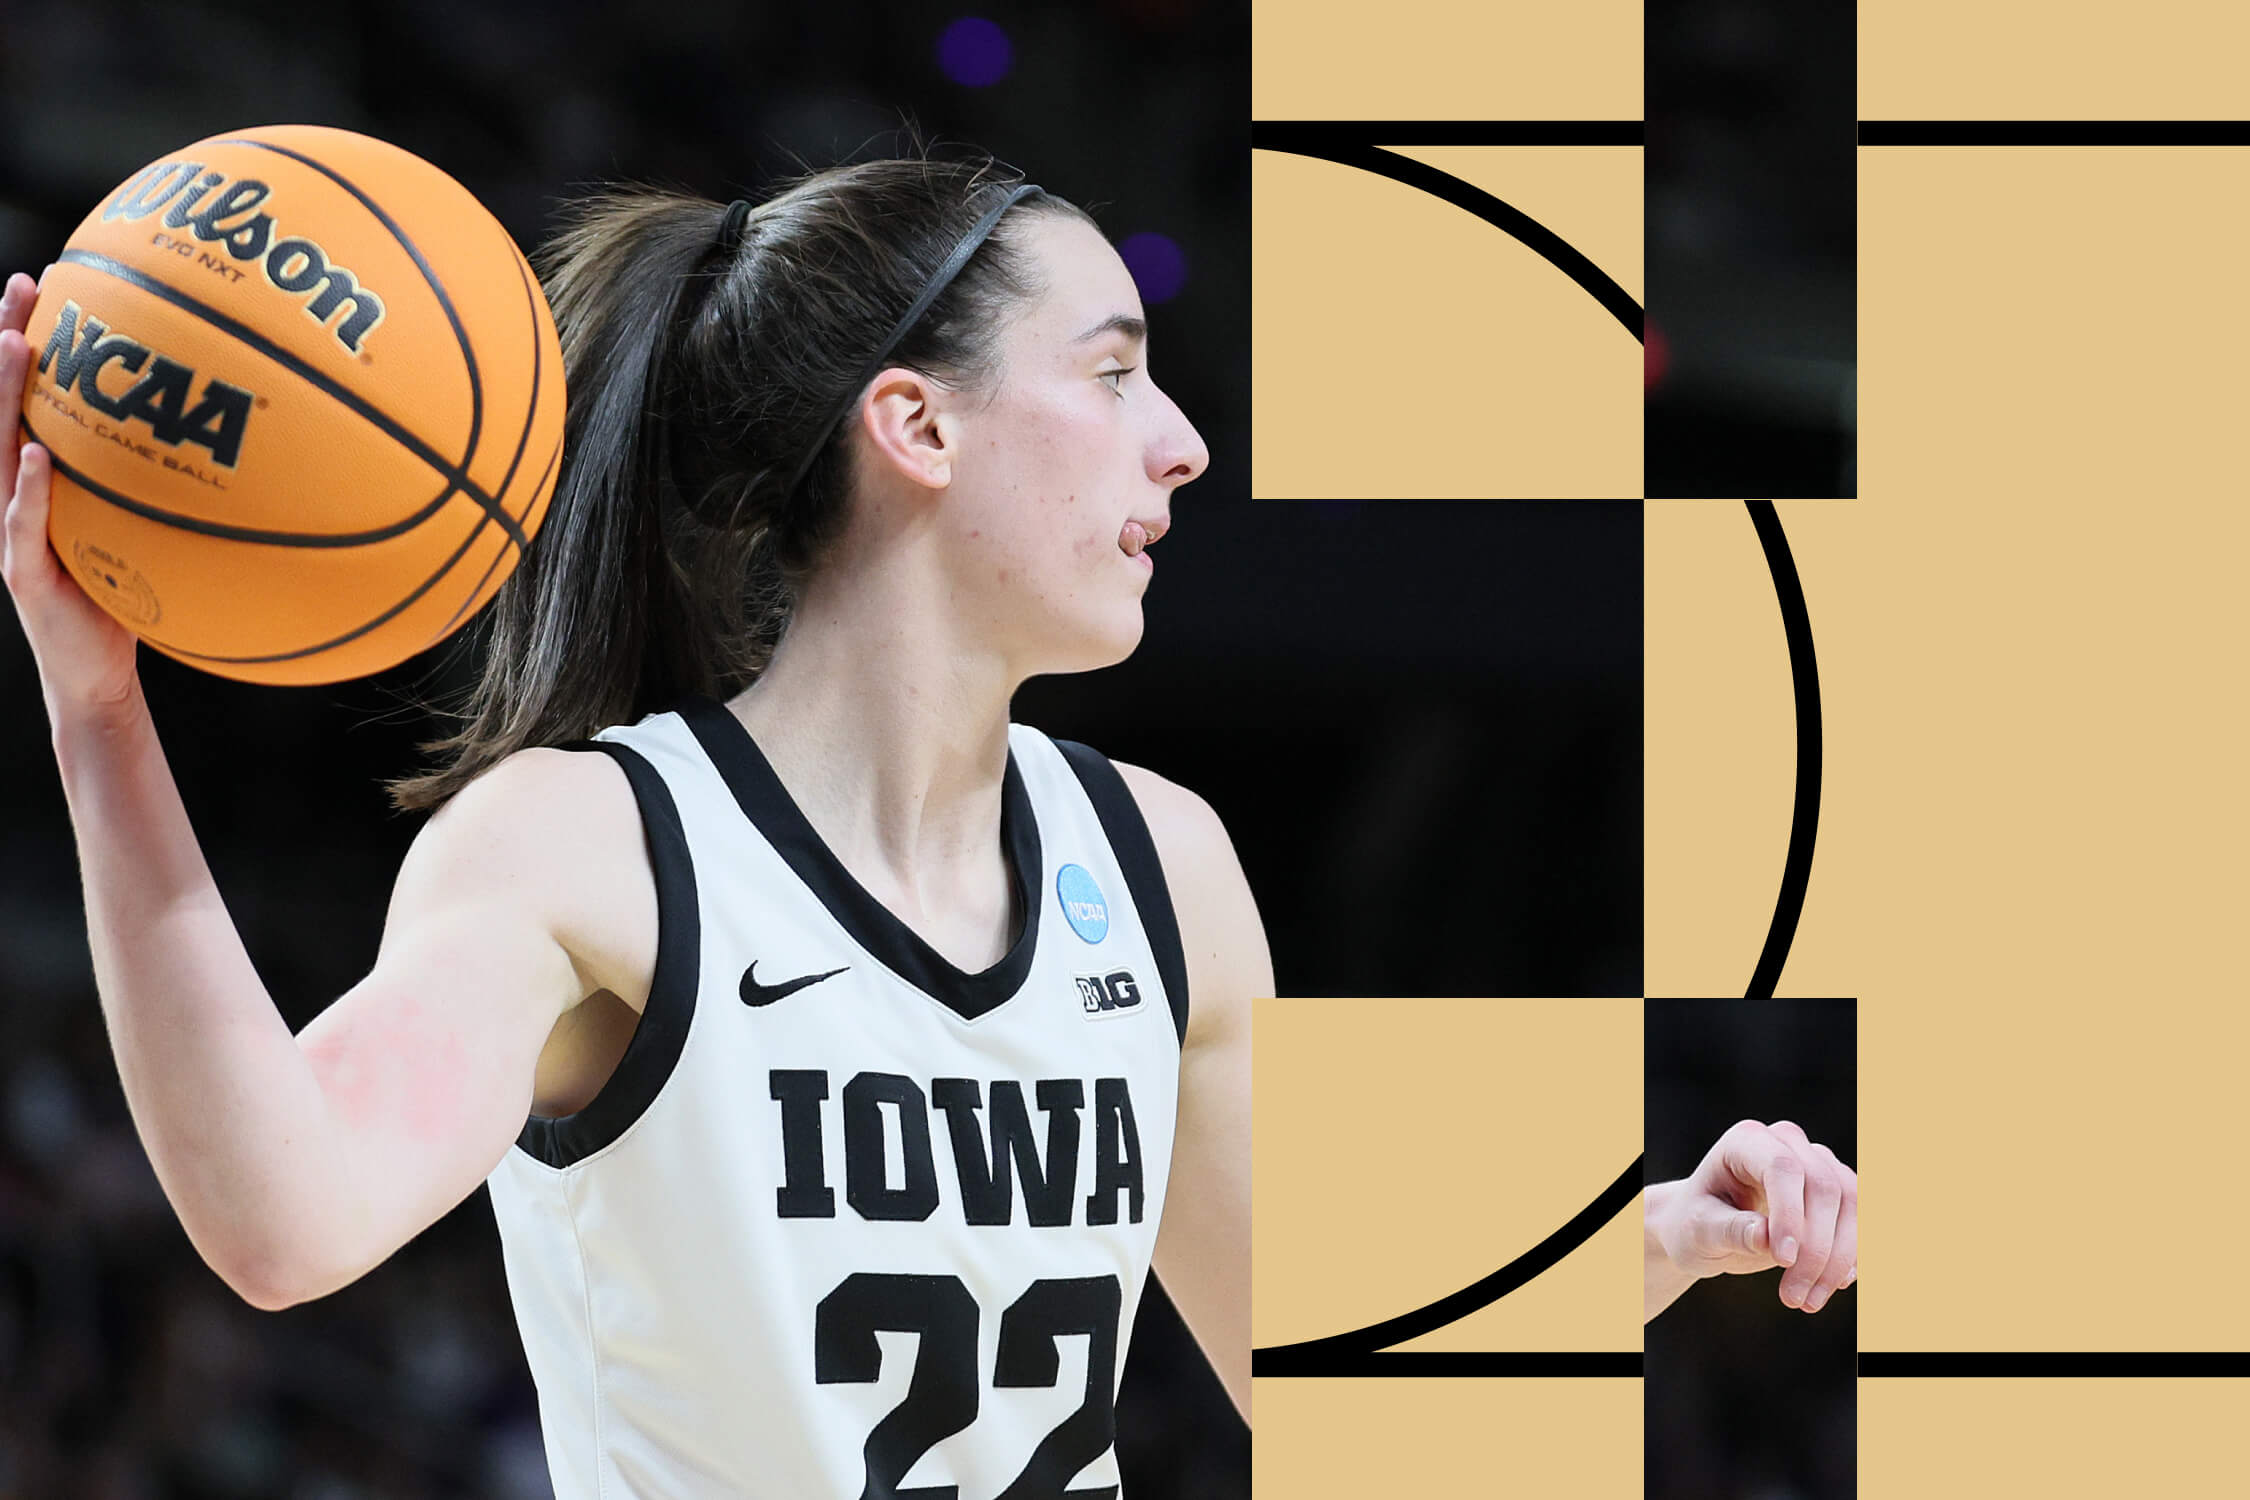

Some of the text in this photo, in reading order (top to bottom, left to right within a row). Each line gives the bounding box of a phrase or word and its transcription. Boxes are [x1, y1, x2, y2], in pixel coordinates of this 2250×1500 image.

[101, 162, 387, 358] Wilson
[151, 232, 246, 284] EVO NXT
[37, 299, 256, 472] NCAA
[94, 423, 158, 464] GAME
[162, 455, 229, 491] BALL
[1067, 901, 1107, 922] NCAA
[769, 1068, 1144, 1228] IOWA
[815, 1272, 1122, 1500] 22
